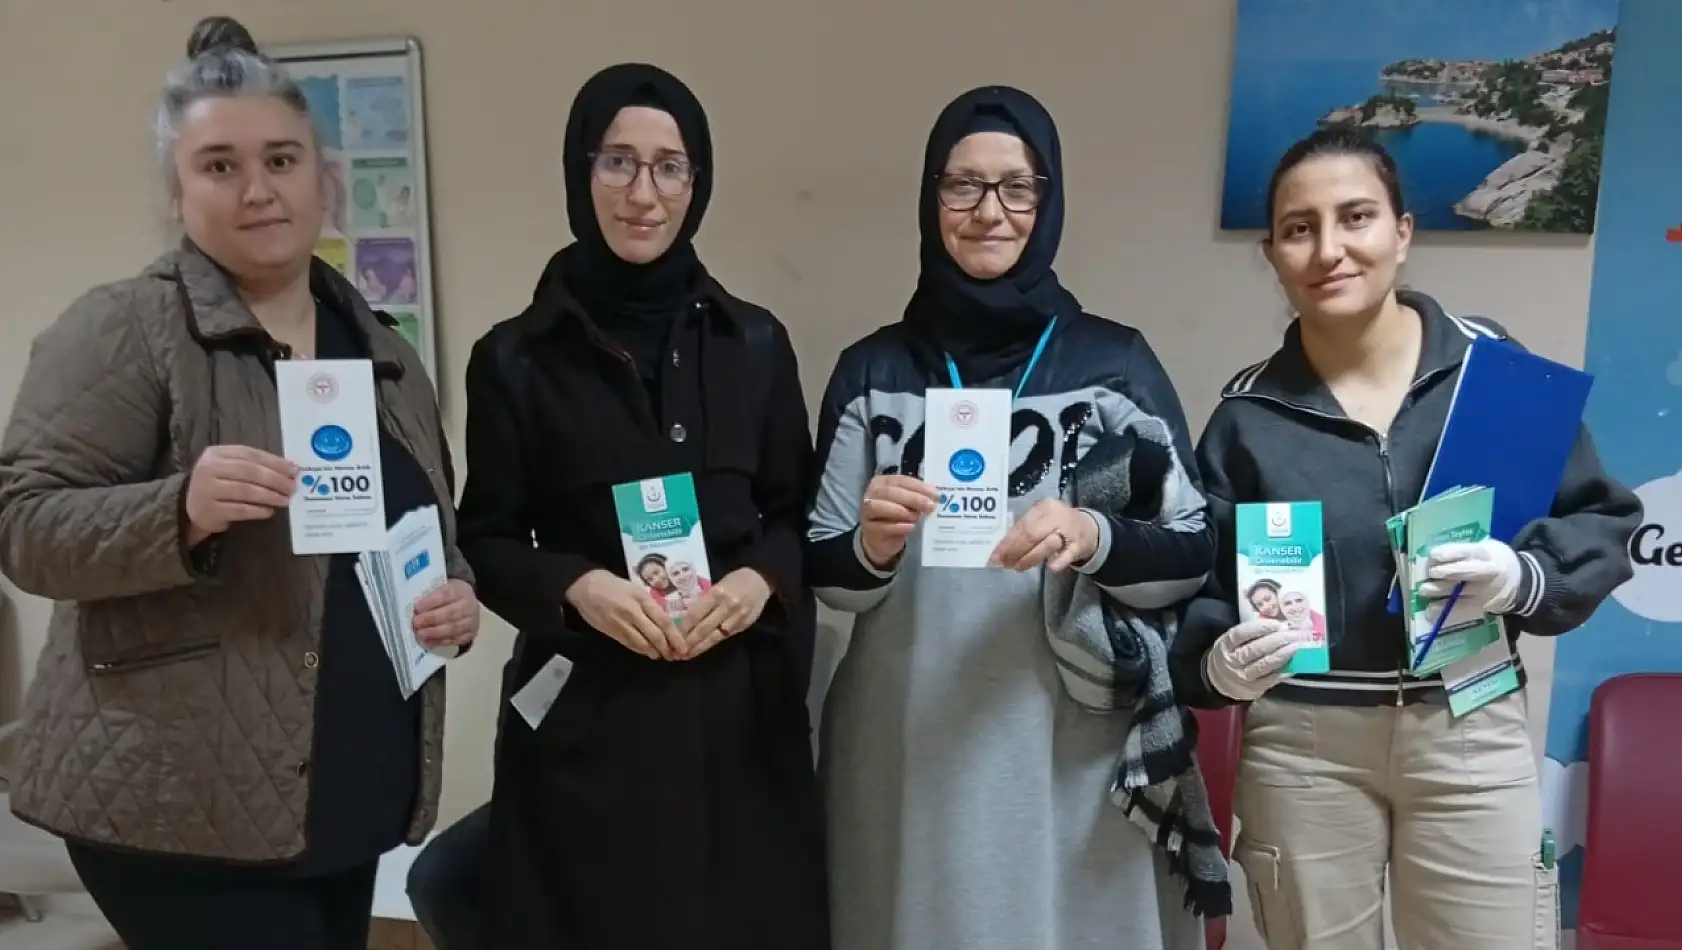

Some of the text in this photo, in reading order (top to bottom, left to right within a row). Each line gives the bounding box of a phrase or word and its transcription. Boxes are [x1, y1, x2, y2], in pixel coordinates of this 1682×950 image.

[301, 474, 370, 496] %100
[938, 493, 996, 513] %100
[636, 517, 682, 532] KANSER
[1255, 545, 1302, 555] KANSER
[1630, 523, 1682, 567] Ge
